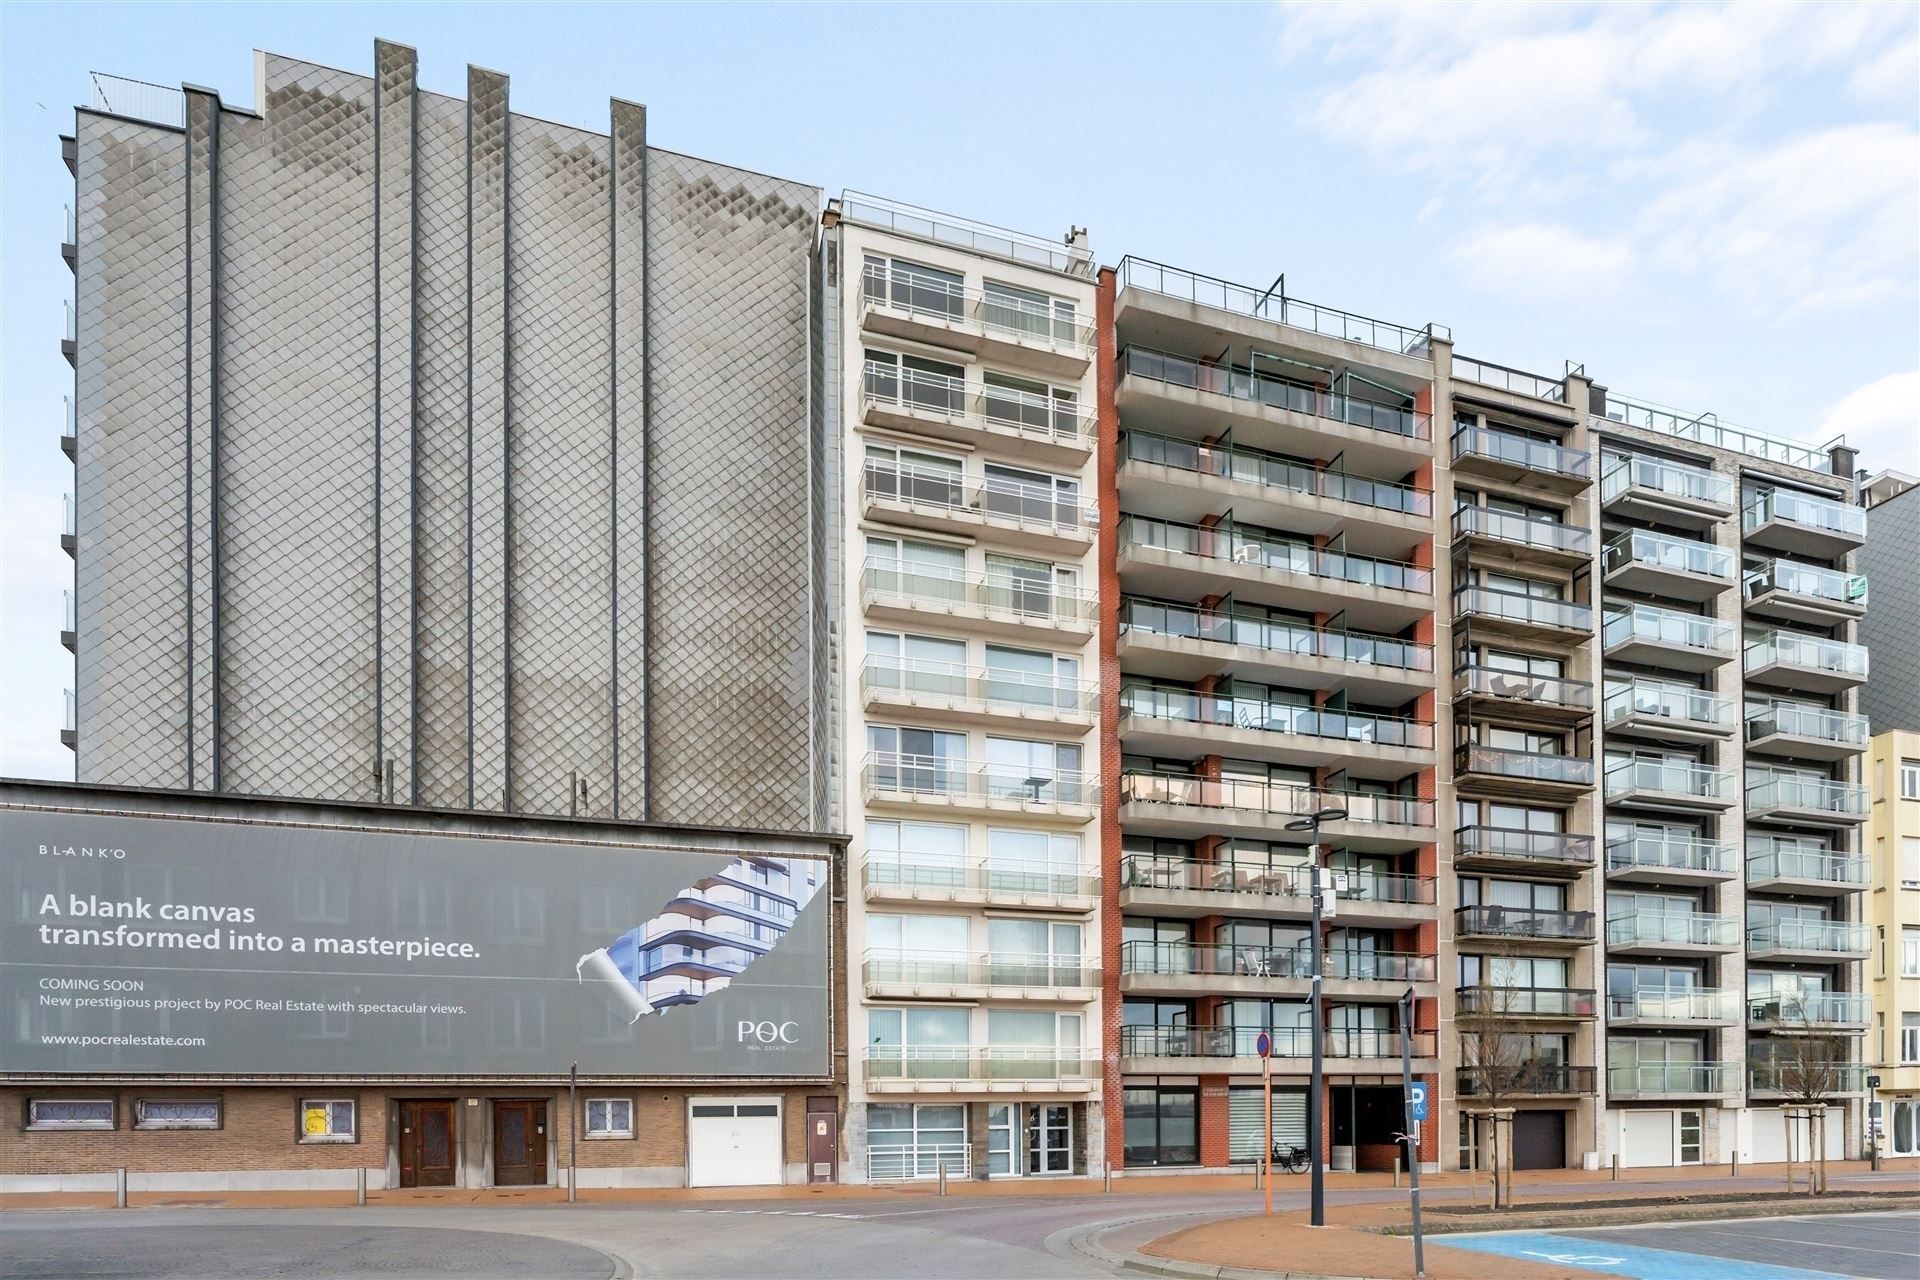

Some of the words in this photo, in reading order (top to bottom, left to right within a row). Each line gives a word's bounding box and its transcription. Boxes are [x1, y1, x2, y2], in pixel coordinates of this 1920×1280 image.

[39, 893, 61, 915] A
[69, 893, 152, 919] blank
[159, 903, 255, 923] canvas
[39, 924, 220, 950] transformed
[229, 929, 284, 951] into
[290, 936, 306, 952] a
[314, 936, 480, 961] masterpiece.
[39, 978, 99, 991] COMING
[102, 980, 144, 992] SOON
[39, 994, 71, 1007] New
[75, 997, 150, 1010] prestigious
[154, 998, 201, 1011] project
[204, 999, 220, 1012] by
[224, 999, 252, 1011] POC
[255, 1000, 282, 1012] Real
[286, 1000, 324, 1013] Estate
[327, 1001, 355, 1013] with
[358, 1002, 427, 1015] spectacular
[430, 1003, 467, 1014] views.
[41, 1034, 206, 1047] www.pocrealestate.com
[738, 1021, 799, 1043] POC
[1411, 1088, 1424, 1104] P
